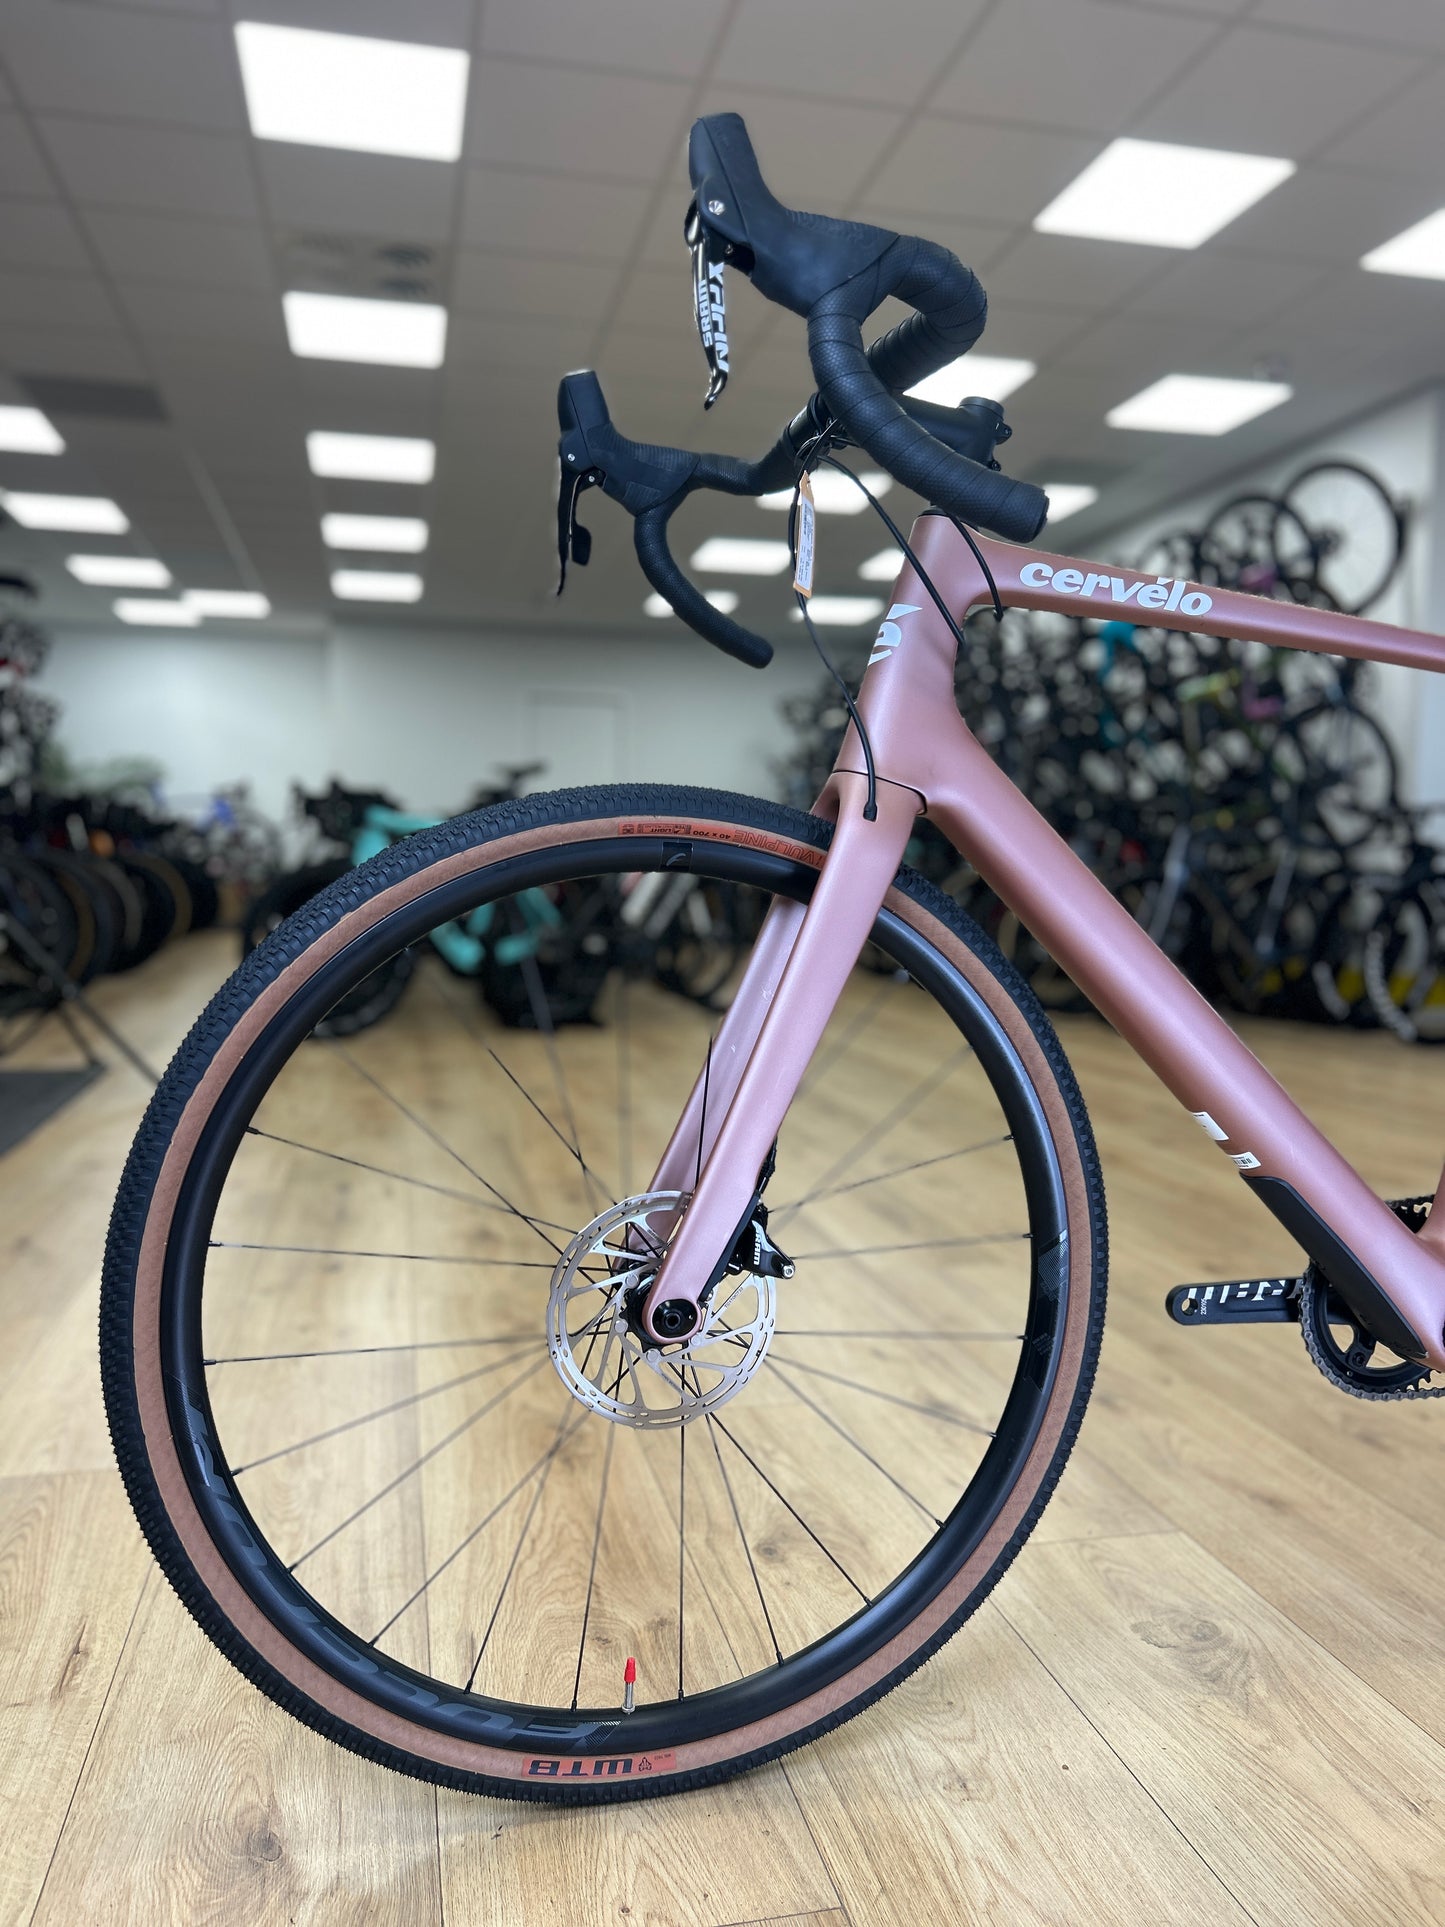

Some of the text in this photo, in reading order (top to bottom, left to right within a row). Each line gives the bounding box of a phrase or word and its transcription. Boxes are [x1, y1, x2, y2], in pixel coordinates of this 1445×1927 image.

[699, 279, 713, 348] SRAM
[1019, 562, 1213, 616] cervélo
[734, 829, 817, 864] VULPINE
[528, 1758, 633, 1776] WTB
